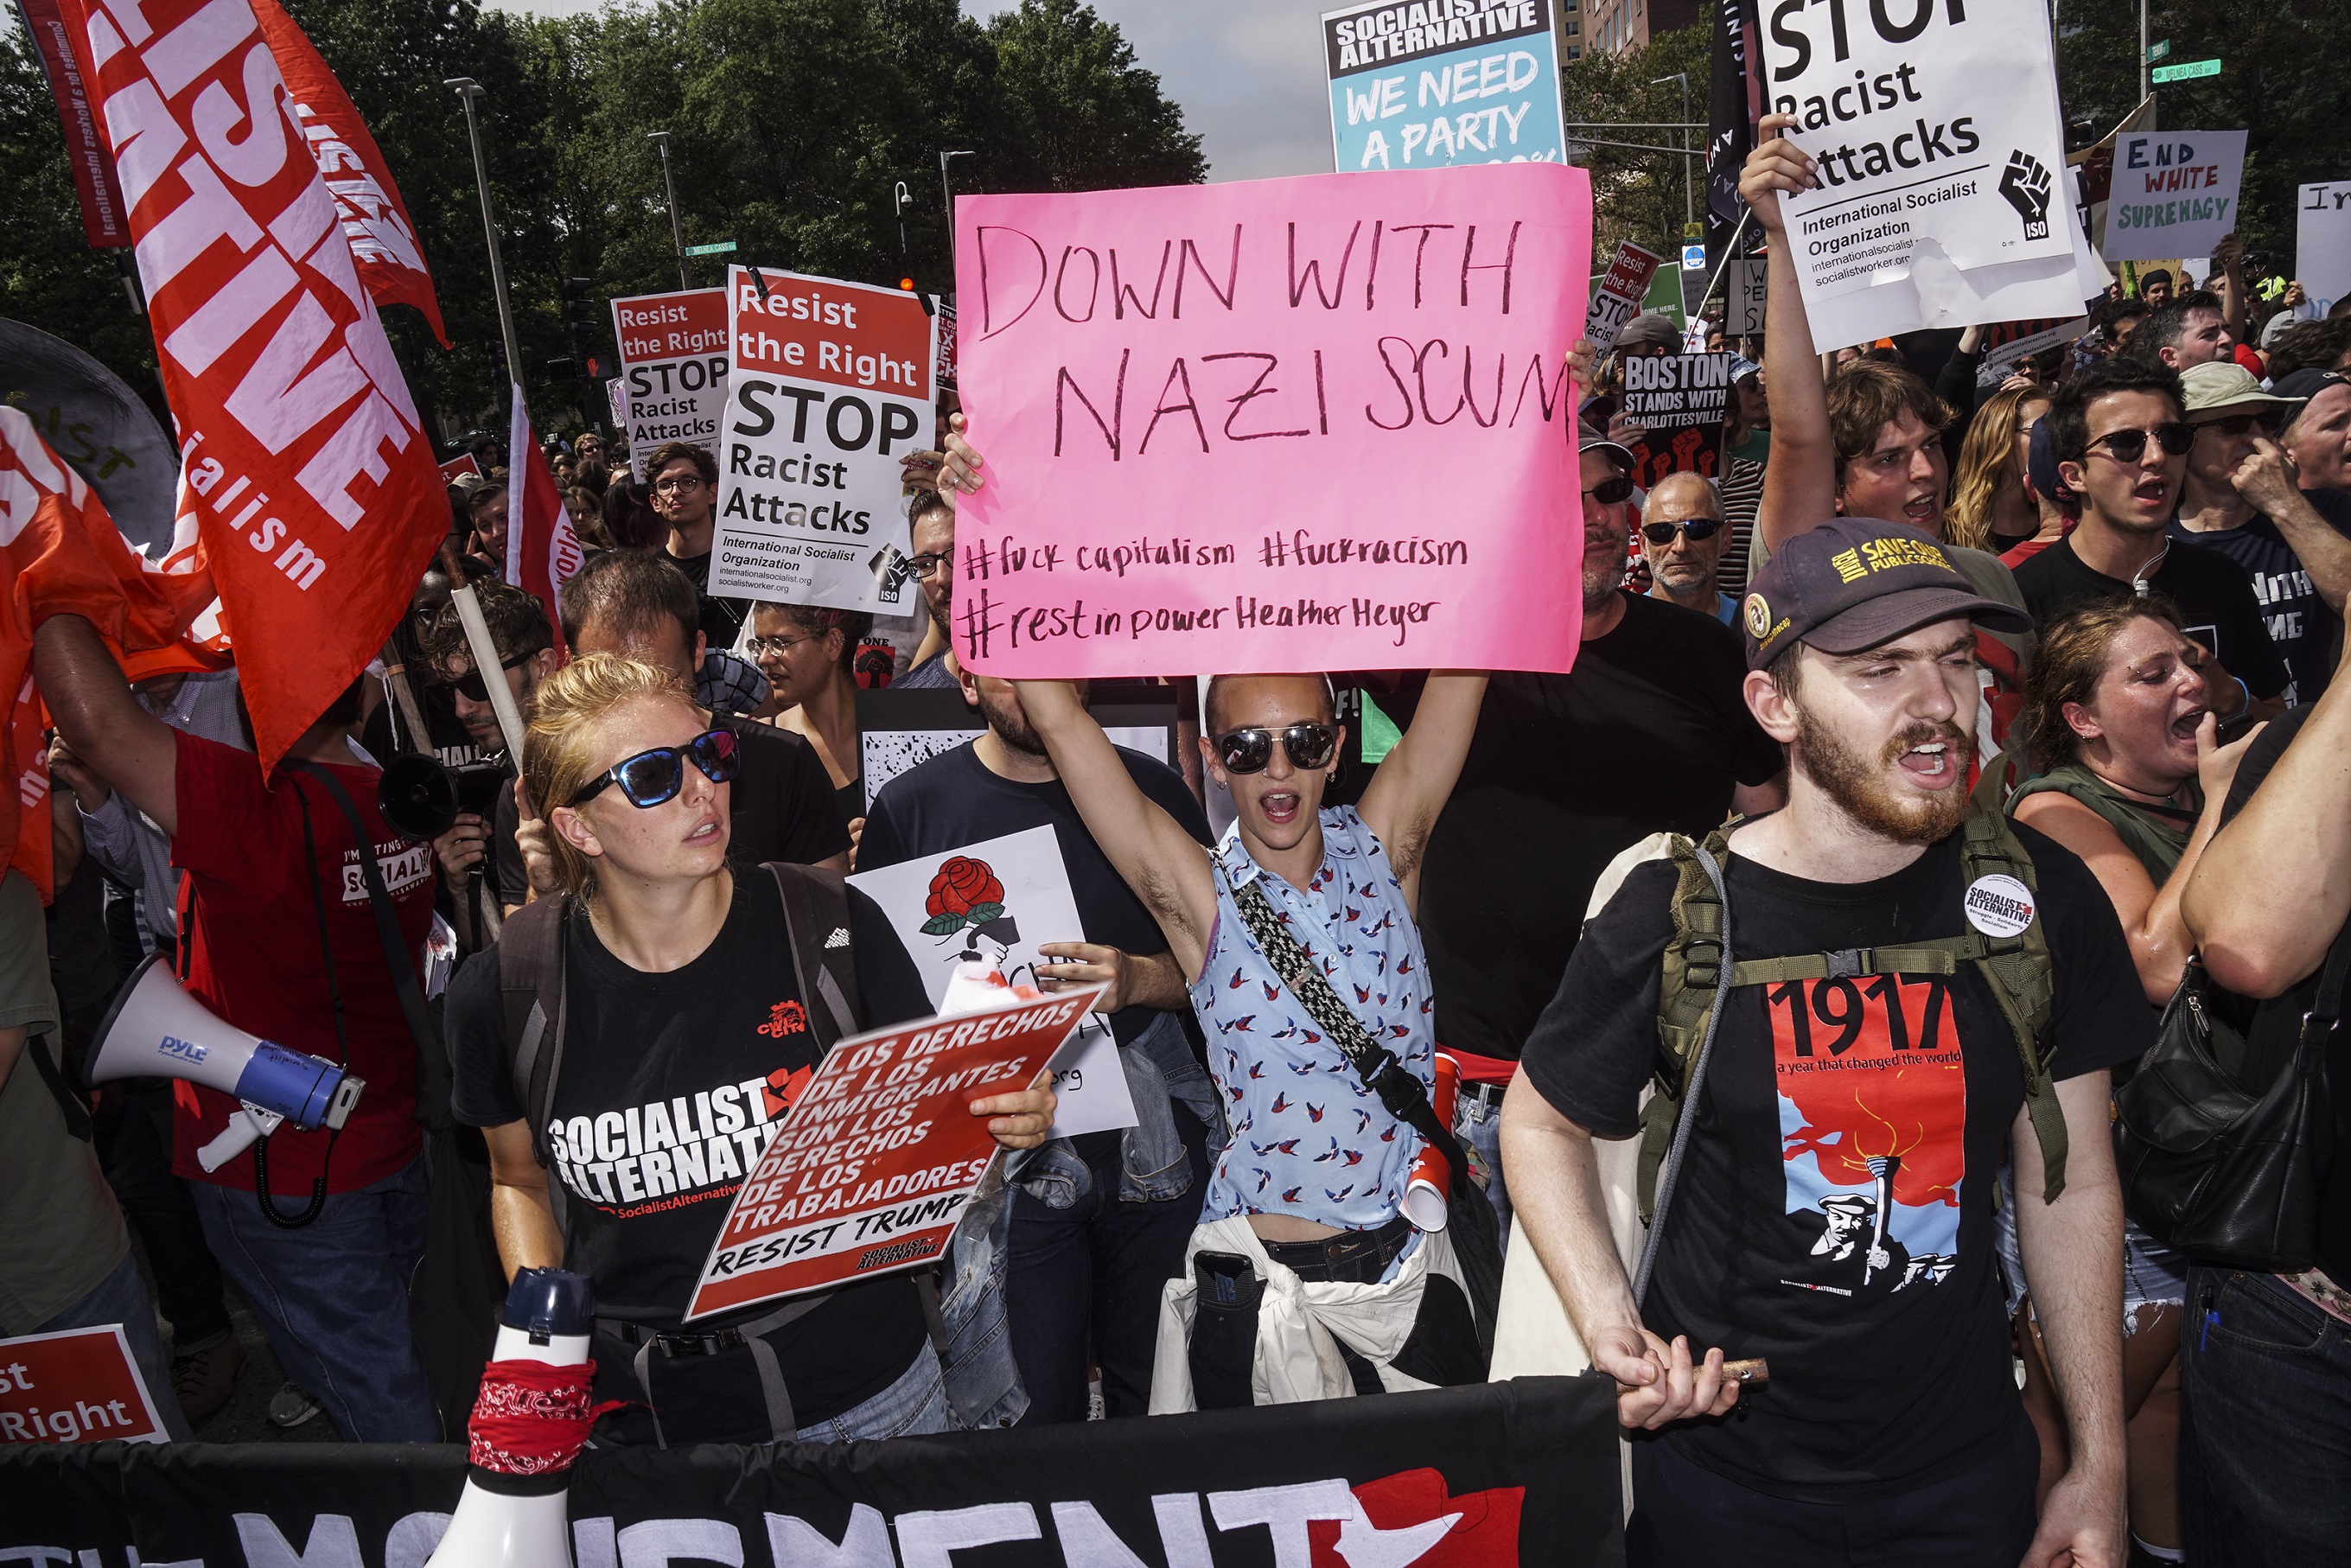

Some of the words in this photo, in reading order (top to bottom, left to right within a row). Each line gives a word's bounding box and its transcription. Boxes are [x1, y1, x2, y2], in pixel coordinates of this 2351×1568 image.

[1340, 1, 1537, 70] ALTERNATIVE
[2166, 67, 2187, 80] MELNEA
[2189, 64, 2202, 76] CASS
[1346, 75, 1407, 126] WE
[1418, 50, 1539, 107] NEED
[1775, 62, 1921, 137] Racist
[1360, 131, 1390, 170] A
[1400, 101, 1532, 164] PARTY
[2127, 139, 2194, 169] END
[2145, 165, 2219, 193] WHITE
[1803, 197, 1902, 236] International
[1906, 180, 1978, 208] Socialist
[1809, 221, 1910, 256] Organization
[2025, 220, 2047, 238] ISO
[694, 245, 713, 253] MELNEA
[715, 243, 728, 252] CASS
[1615, 249, 1646, 274] Resist
[977, 223, 1242, 342] DOWN
[1288, 220, 1522, 314] WITH
[1605, 271, 1623, 290] the
[621, 305, 688, 327] Resist
[740, 284, 858, 329] Resist
[1589, 294, 1634, 328] STOP
[623, 337, 661, 356] the
[668, 328, 727, 352] Right
[739, 331, 808, 367] the
[818, 341, 918, 387] Right
[1625, 354, 1730, 391] BOSTON
[629, 357, 729, 398] STOP
[631, 397, 698, 419] Racist
[1054, 348, 1328, 462] NAZI
[1366, 336, 1572, 447] SCUM
[1625, 392, 1684, 412] STANDS
[1687, 389, 1727, 409] WITH
[634, 417, 716, 442] Attacks
[733, 381, 919, 456] STOP
[730, 443, 848, 490] Racist
[724, 488, 871, 535] Attacks
[722, 552, 800, 571] Organization
[723, 536, 801, 556] International
[804, 546, 856, 562] Socialist
[965, 535, 1065, 581] #fuck
[1076, 536, 1235, 577] capitalism
[1258, 530, 1469, 571] #fuckracism
[1861, 539, 1916, 561] SAVE
[1870, 555, 1914, 572] PUBLIC
[718, 578, 789, 593] socialistworker.org
[719, 567, 812, 586] internationalsocialist.org
[880, 590, 898, 602] ISO
[863, 638, 889, 647] ONE
[1966, 896, 2031, 925] ALTERNATIVE
[1970, 887, 2023, 910] SOCIALIST
[1981, 918, 2008, 930] Socialism
[1768, 972, 1946, 1057] 1917
[159, 1036, 209, 1062] PYLE
[820, 1038, 896, 1079] LOS
[902, 1000, 1079, 1055] DERECHOS
[157, 1049, 203, 1066] PyleAudio.com
[1777, 1063, 1785, 1073] a
[1788, 1061, 1814, 1075] year
[1817, 1059, 1844, 1072] that
[1846, 1054, 1898, 1072] changed
[1902, 1052, 1921, 1065] the
[1925, 1049, 1961, 1063] world
[788, 1056, 1028, 1128] INMIGRANTES
[807, 1072, 859, 1106] DE
[863, 1057, 934, 1091] LOS
[548, 1077, 768, 1165] SOCIALIST
[770, 1123, 842, 1156] SON
[847, 1103, 918, 1137] LOS
[753, 1120, 933, 1182] DERECHOS
[732, 1158, 987, 1234] TRABAJADORES
[741, 1175, 793, 1208] DE
[796, 1159, 862, 1194] LOS
[710, 1221, 848, 1278] RESIST
[854, 1194, 970, 1241] TRUMP
[861, 1237, 928, 1262] SOCIALIST
[856, 1243, 940, 1271] ALTERNATIVE
[1781, 1279, 1810, 1288] SOCIALIST
[1816, 1285, 1852, 1297] ALTERNATIVE
[0, 1399, 133, 1442] Right
